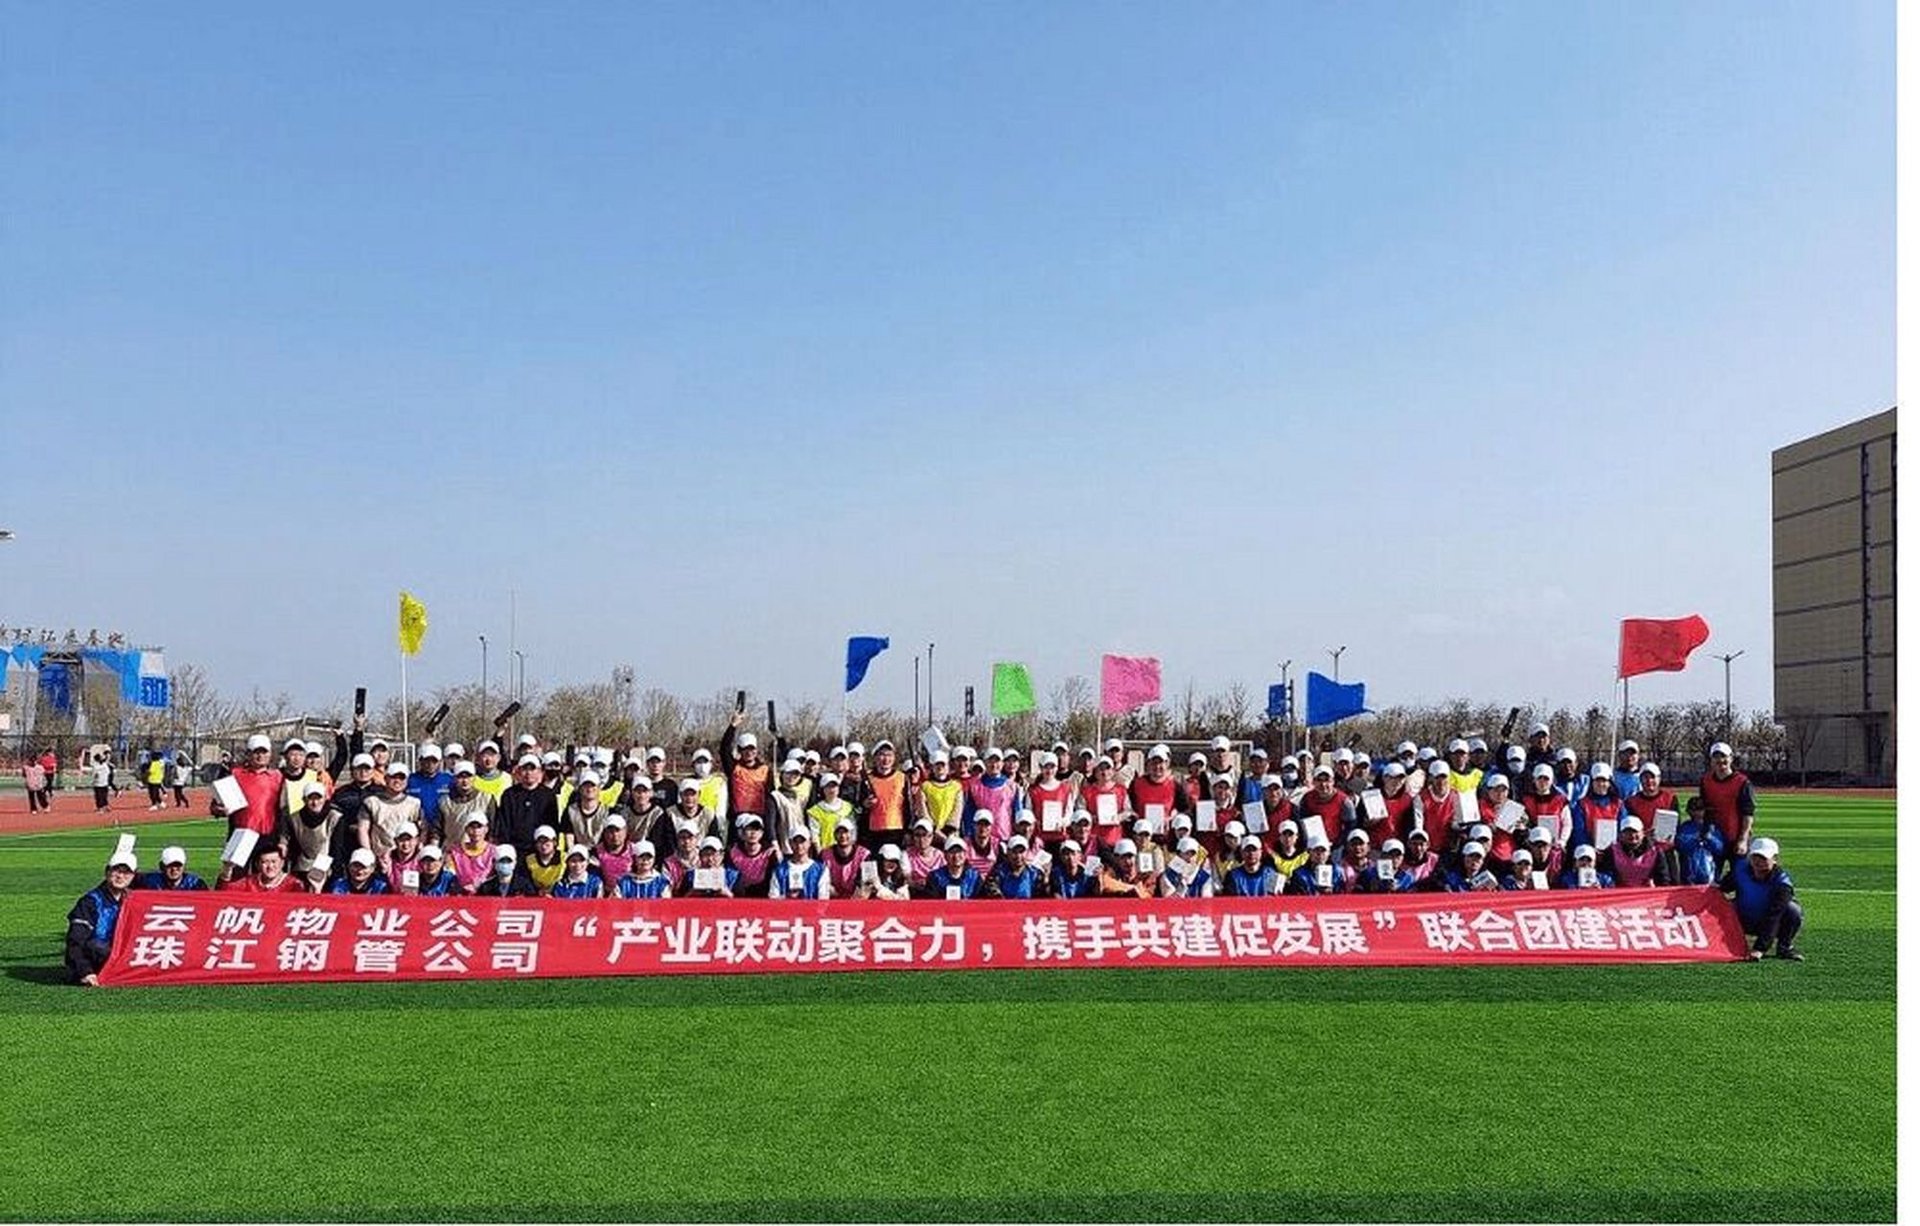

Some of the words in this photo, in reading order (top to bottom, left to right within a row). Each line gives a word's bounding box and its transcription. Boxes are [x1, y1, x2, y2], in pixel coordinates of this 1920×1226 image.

[142, 906, 546, 938] 云帆物业公司
[130, 936, 539, 972] 珠江钢管公司
